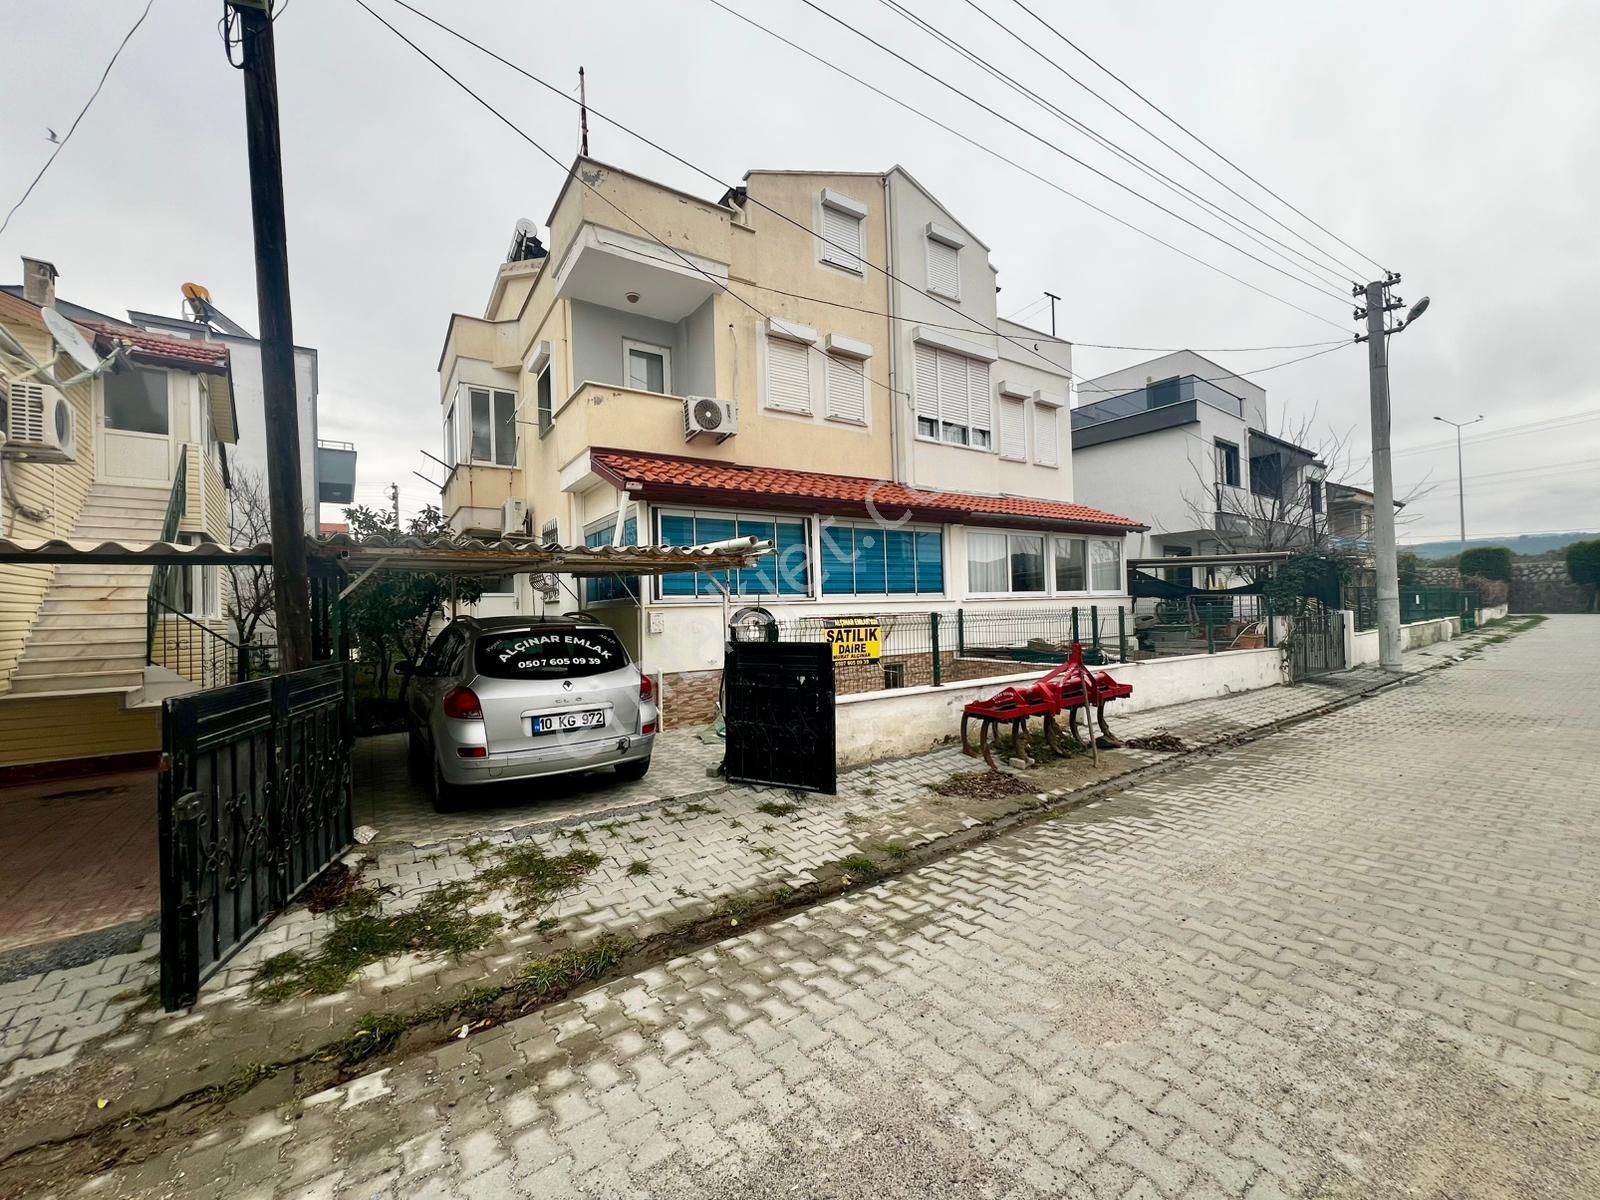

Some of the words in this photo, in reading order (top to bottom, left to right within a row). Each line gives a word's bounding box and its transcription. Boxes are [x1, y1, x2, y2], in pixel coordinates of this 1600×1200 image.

[826, 629, 878, 643] SATILIK
[498, 635, 560, 663] ALÇINAR
[564, 635, 613, 660] EMLAK
[518, 659, 547, 669] 0507
[549, 657, 570, 666] 605
[572, 657, 586, 665] 09
[588, 657, 601, 665] 39
[540, 718, 552, 730] 10
[558, 715, 576, 728] KG
[582, 712, 603, 725] 972
